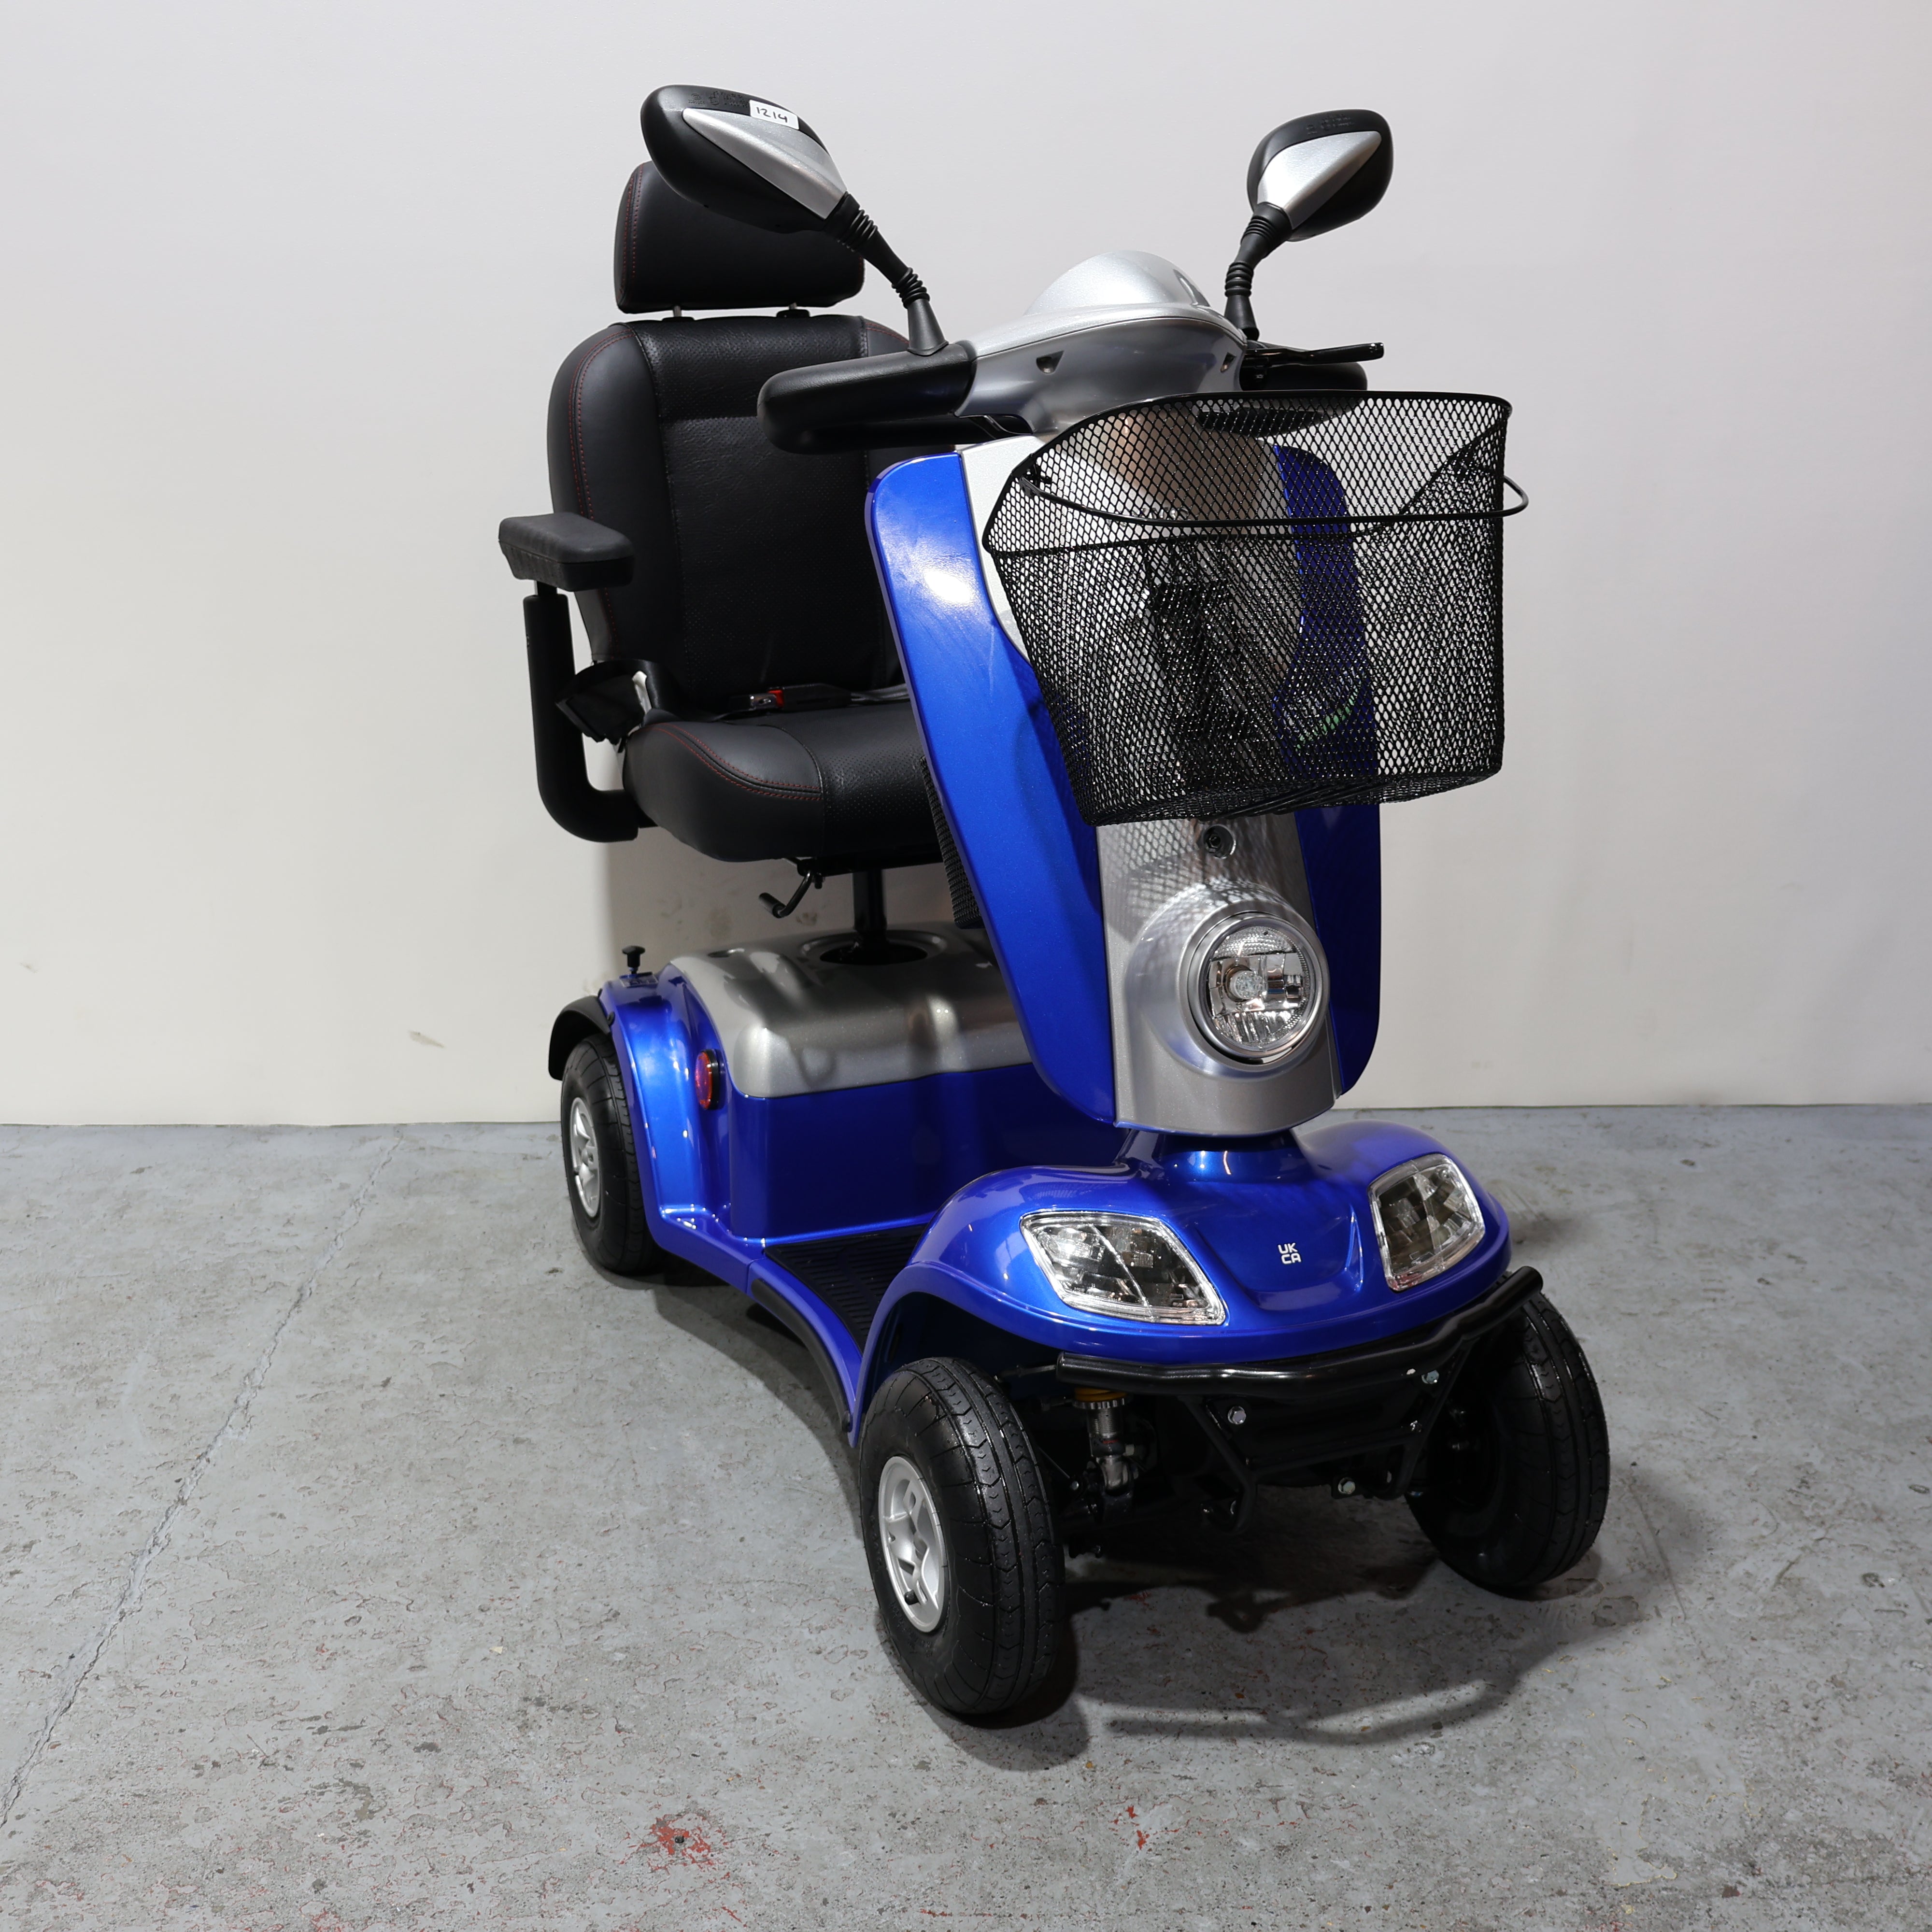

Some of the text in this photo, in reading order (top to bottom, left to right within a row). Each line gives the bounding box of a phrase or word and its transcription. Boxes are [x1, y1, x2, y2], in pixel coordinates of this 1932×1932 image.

[756, 106, 788, 123] 1214
[1278, 1242, 1298, 1254] UK
[1281, 1252, 1302, 1264] CA
